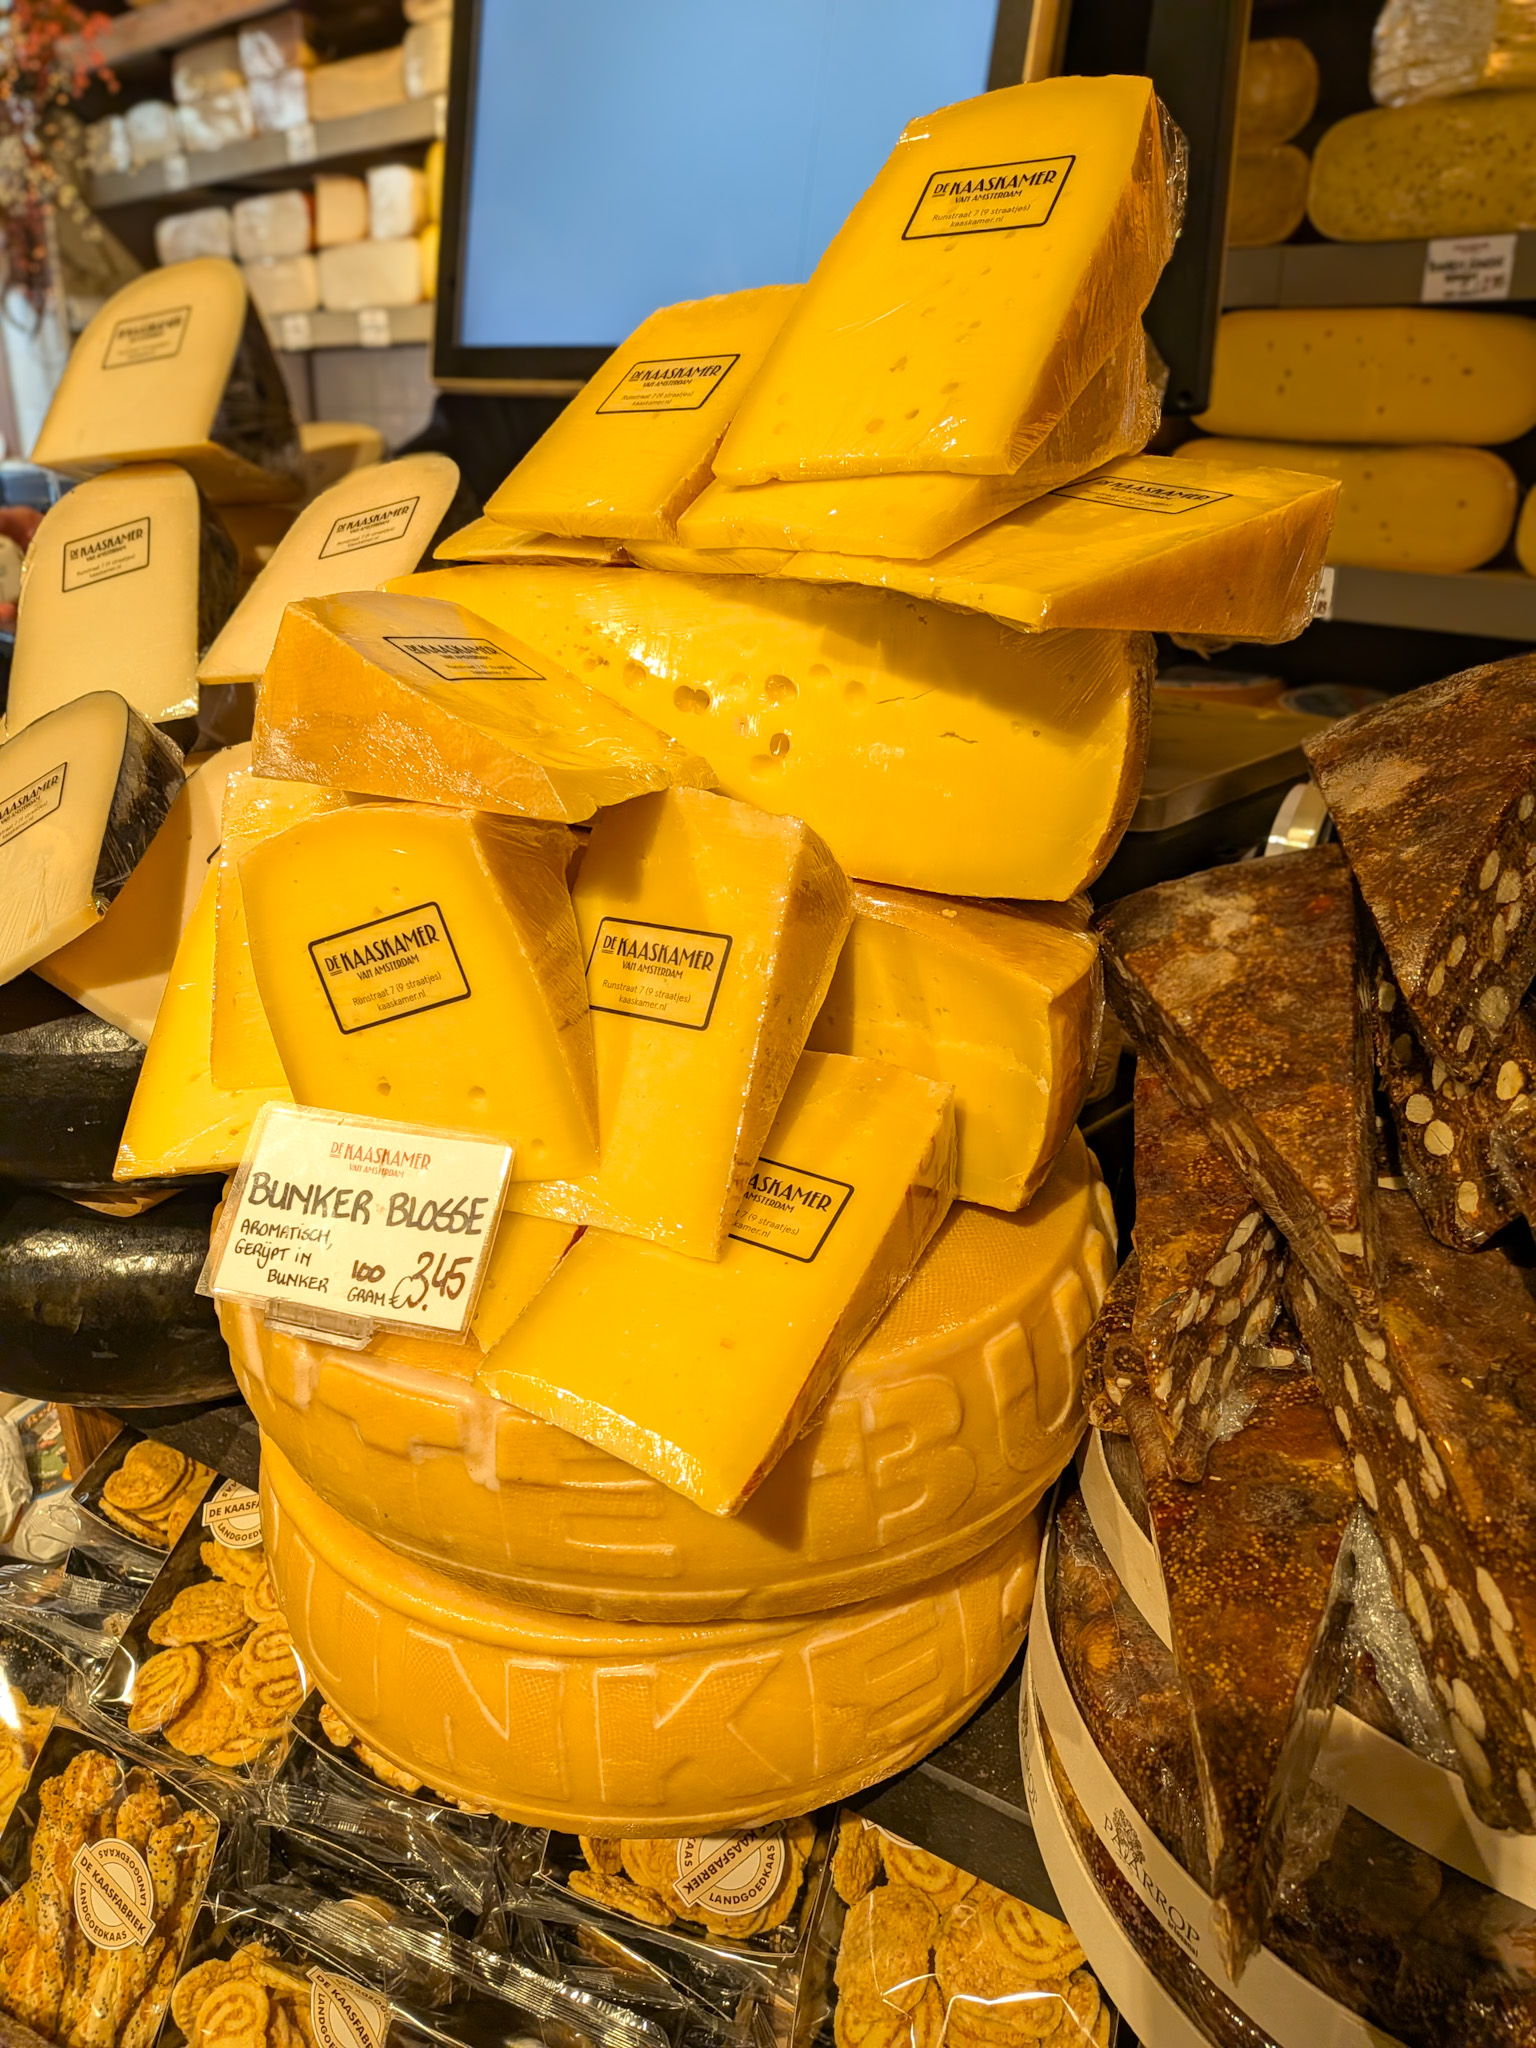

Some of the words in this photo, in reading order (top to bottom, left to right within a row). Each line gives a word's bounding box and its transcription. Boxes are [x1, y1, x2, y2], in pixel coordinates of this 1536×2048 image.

[933, 183, 950, 197] DE
[949, 170, 1057, 196] KAASKAMER
[955, 195, 971, 203] VAN
[972, 190, 1023, 201] AMSTERDAM
[932, 211, 973, 221] Runstraat
[980, 208, 989, 216] (9
[990, 204, 1031, 215] straatjes)
[950, 216, 1004, 228] kaaskamer.nl
[641, 365, 721, 381] KAASKAMER
[80, 528, 143, 558] KAASKAMER
[0, 775, 58, 820] AASKAMER
[324, 954, 342, 976] DE
[340, 924, 440, 972] KAASKAMER
[602, 935, 618, 953] DE
[616, 937, 714, 971] KAASKAMER
[357, 968, 373, 980] VAN
[374, 953, 420, 977] AMSTERDAM
[622, 960, 637, 971] VAN
[637, 964, 684, 979] AMSTERDAM
[352, 989, 390, 1006] Runstraat
[390, 985, 394, 994] 7
[396, 982, 404, 993] (9
[405, 971, 441, 990] straatjes)
[377, 989, 426, 1011] kaaskamer.nl
[602, 979, 638, 994] Runstraat
[639, 986, 645, 994] 7
[645, 986, 654, 996] (9
[654, 989, 691, 1004] straatjes)
[619, 994, 667, 1011] kaaskamer.nl
[330, 1141, 345, 1157] DE
[343, 1142, 431, 1170] KAASKAMER
[349, 1163, 363, 1173] VAN
[362, 1165, 405, 1179] AMSTERDAM
[248, 1171, 374, 1226] BUNKER
[386, 1191, 489, 1236] BLOSSE
[743, 1191, 795, 1213] AMSTERDAM
[748, 1173, 832, 1212] ASKAMER
[734, 1220, 771, 1238] kamer.nl
[759, 1216, 800, 1235] straatjes)
[267, 1268, 329, 1294] BUNKER
[351, 1259, 386, 1283] 100
[347, 1286, 386, 1307] GRAM
[209, 1507, 222, 1518] DE
[682, 1829, 759, 1895] KAASFABRIEK
[709, 1844, 776, 1905] LANDGOEDKAAS
[98, 1848, 147, 1906] LANDGOEDKAAS
[80, 1856, 94, 1873] DE
[92, 1869, 147, 1936] KAASFABRIEK
[80, 1882, 128, 1942] LANDGOEDKAAS
[316, 1974, 331, 1989] DE
